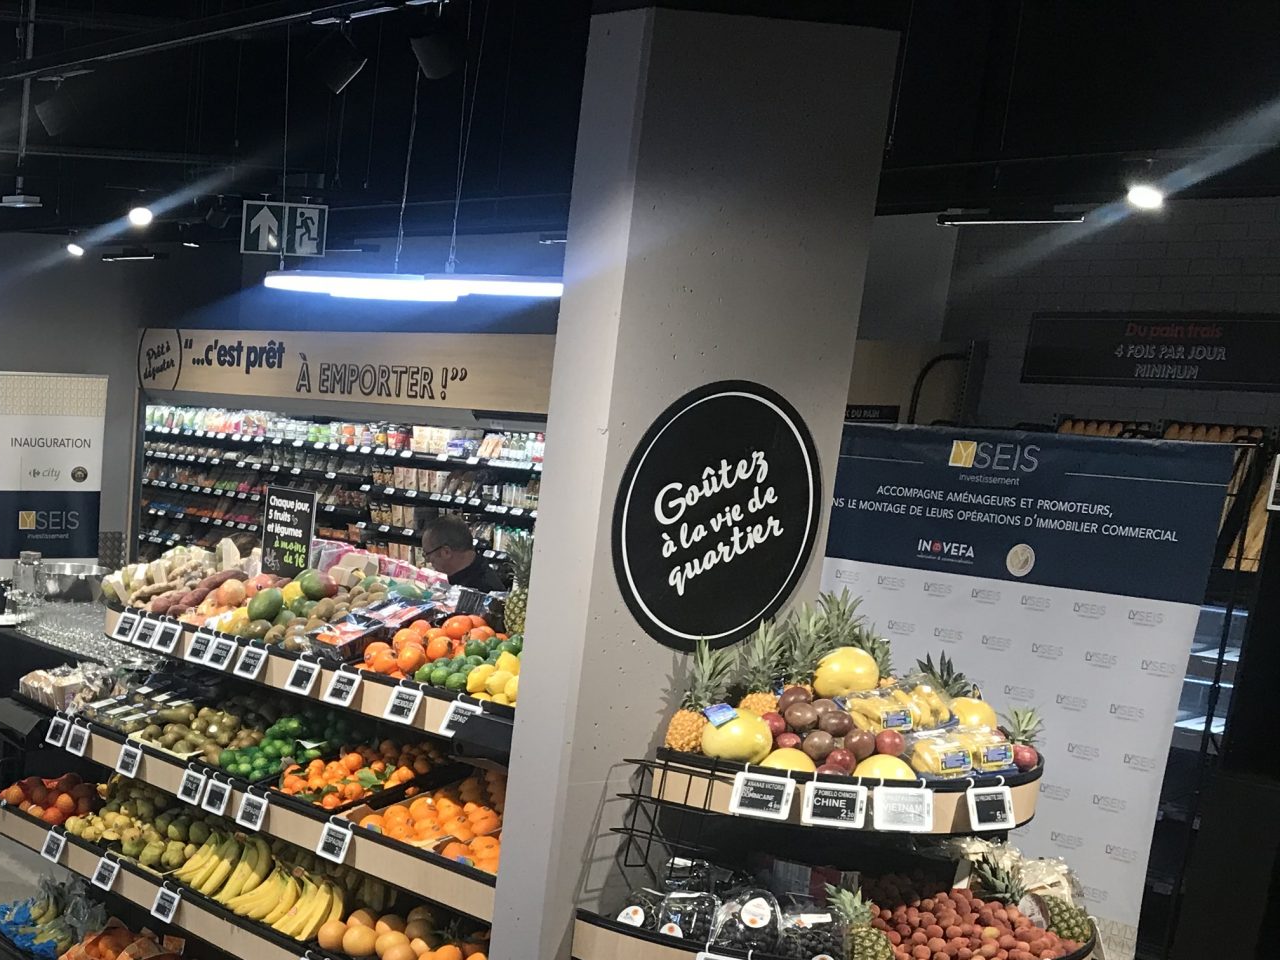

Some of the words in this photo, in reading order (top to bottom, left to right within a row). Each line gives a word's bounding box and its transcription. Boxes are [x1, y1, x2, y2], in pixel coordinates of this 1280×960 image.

[1125, 322, 1145, 337] Du
[1149, 325, 1185, 341] pain
[1187, 323, 1223, 338] frais
[245, 341, 285, 373] prêt
[1126, 344, 1156, 359] FOIS
[1158, 345, 1185, 360] PAR
[1187, 346, 1226, 361] JOUR
[296, 352, 310, 393] À
[318, 362, 434, 400] EMPORTER
[1134, 363, 1199, 379] MINIMUM
[10, 437, 92, 449] INAUGURATION
[41, 467, 61, 481] city
[959, 473, 1020, 486] investissement
[654, 450, 769, 525] Goûtez
[269, 495, 295, 510] Chaque
[294, 500, 310, 513] jour,
[877, 485, 944, 501] ACCOMPAGNE
[946, 491, 1017, 508] AMÉNAGEURS
[1020, 498, 1034, 508] ET
[1037, 500, 1113, 518] PROMOTEURS,
[268, 508, 273, 519] 5
[274, 509, 291, 523] fruits
[662, 532, 677, 558] à
[679, 523, 707, 549] la
[710, 504, 744, 532] vie
[748, 486, 778, 513] de
[848, 500, 857, 509] LE
[859, 501, 907, 514] MONTAGE
[909, 506, 923, 516] DE
[926, 509, 954, 519] LEURS
[957, 511, 1021, 526] OPÉRATIONS
[1024, 514, 1098, 534] D'IMMOBILIER
[1101, 524, 1179, 542] COMMERCIAL
[267, 523, 274, 532] et
[275, 523, 303, 538] légumes
[274, 536, 279, 547] à
[281, 540, 306, 553] moins
[283, 551, 293, 564] de
[295, 554, 305, 567] 1€
[669, 516, 784, 596] quartier
[814, 797, 847, 808] CHINE
[885, 802, 924, 812] VIETNAM
